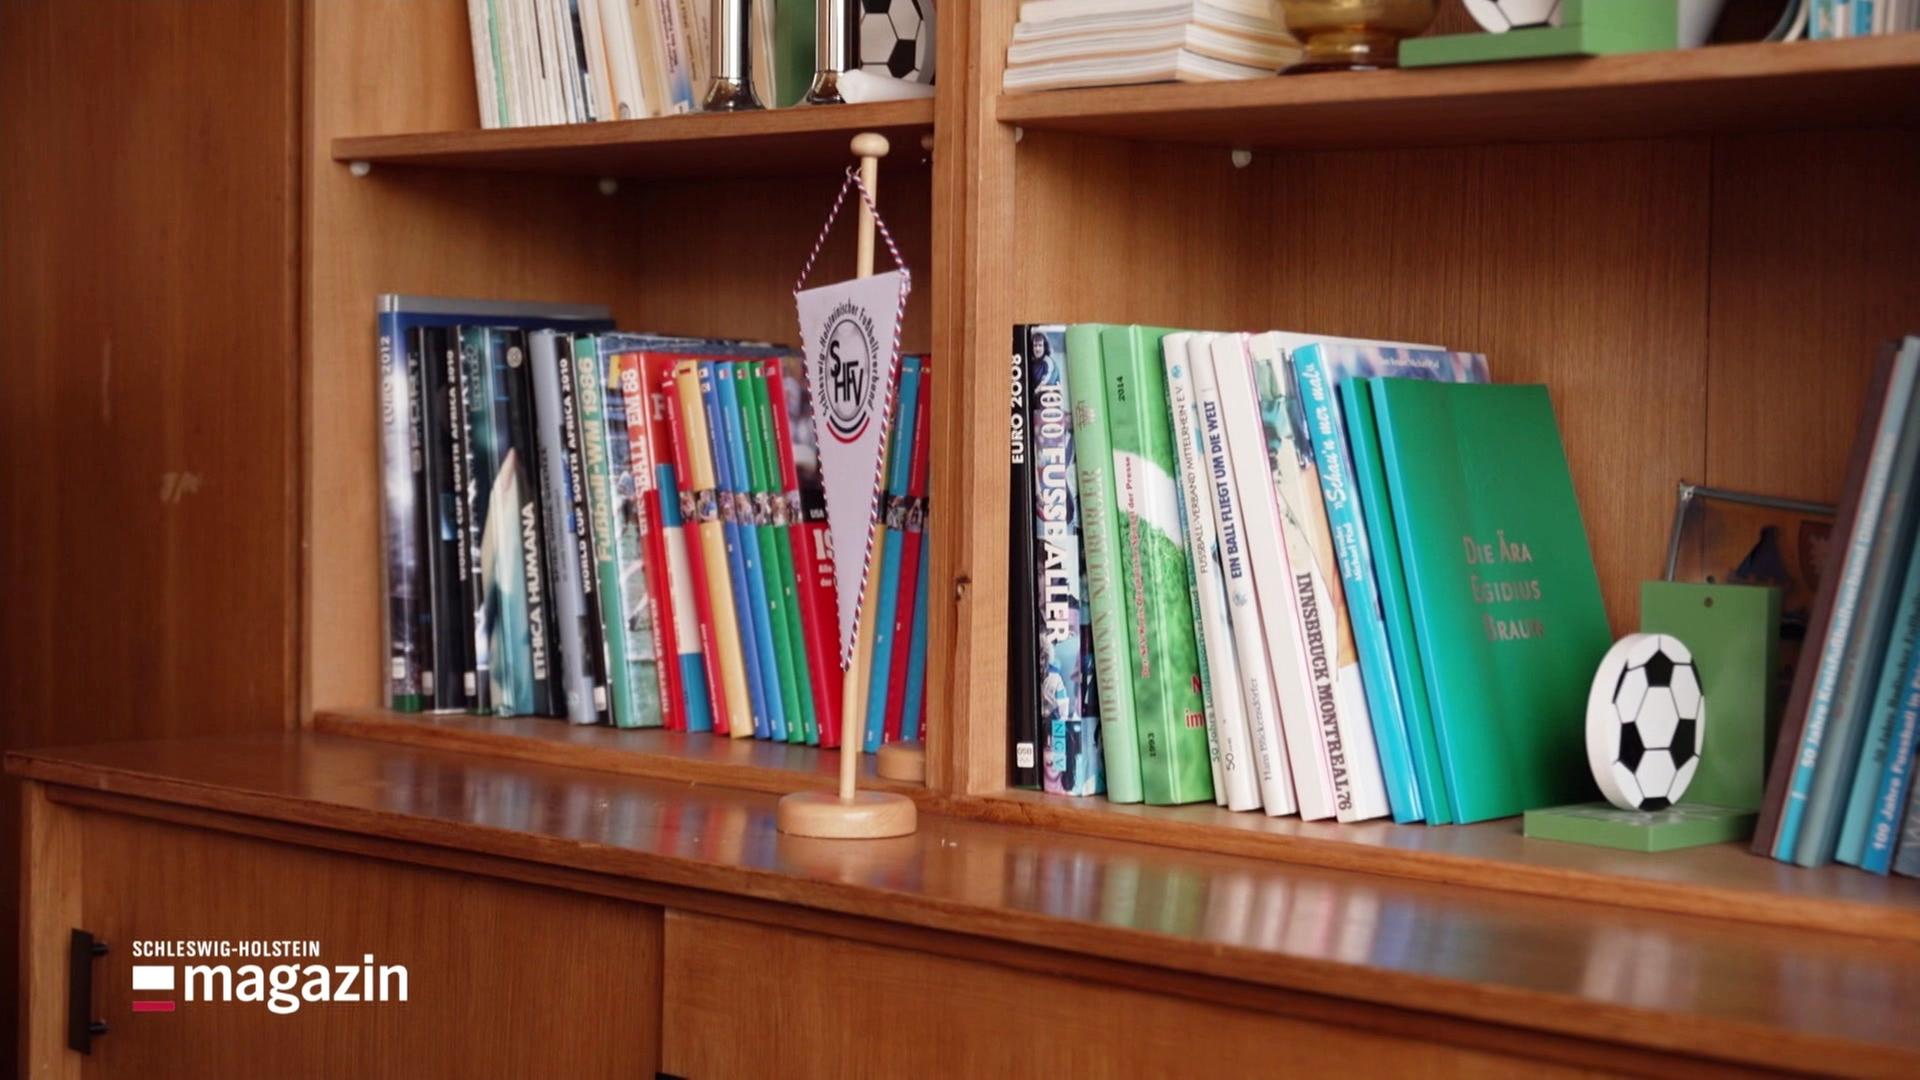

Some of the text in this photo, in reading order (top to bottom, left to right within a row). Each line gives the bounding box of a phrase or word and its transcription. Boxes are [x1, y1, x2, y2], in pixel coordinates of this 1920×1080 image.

[379, 335, 392, 371] 2012
[621, 369, 640, 393] 88
[1117, 375, 1127, 402] 2014
[625, 399, 645, 427] EM
[1010, 353, 1024, 464] EURO 2008
[577, 356, 613, 562] Fußball-WM 1986
[1177, 403, 1195, 470] MITTELRHEIN
[445, 349, 467, 581] WORLD CUP SOUTH AFRICA 2010
[558, 358, 592, 593] WORLD CUP SOUTH AFRICA 2010
[1125, 456, 1133, 489] Presse
[1038, 380, 1071, 644] 1000 FUSSBALLER
[1127, 493, 1136, 509] der
[1203, 400, 1243, 580] EIN BALL FLIEGT UM DIE WELT
[521, 501, 546, 680] ETHICA HUMANA
[1297, 572, 1329, 683] INNSBRUCK
[1317, 682, 1347, 791] MONTREAL
[1208, 711, 1220, 744] Jahre
[1807, 703, 1830, 751] Jahre
[1890, 710, 1917, 774] Fussball
[1225, 751, 1236, 772] 50
[1262, 753, 1273, 782] Hans
[1880, 777, 1903, 822] Jahre
[1872, 824, 1891, 849] 100
